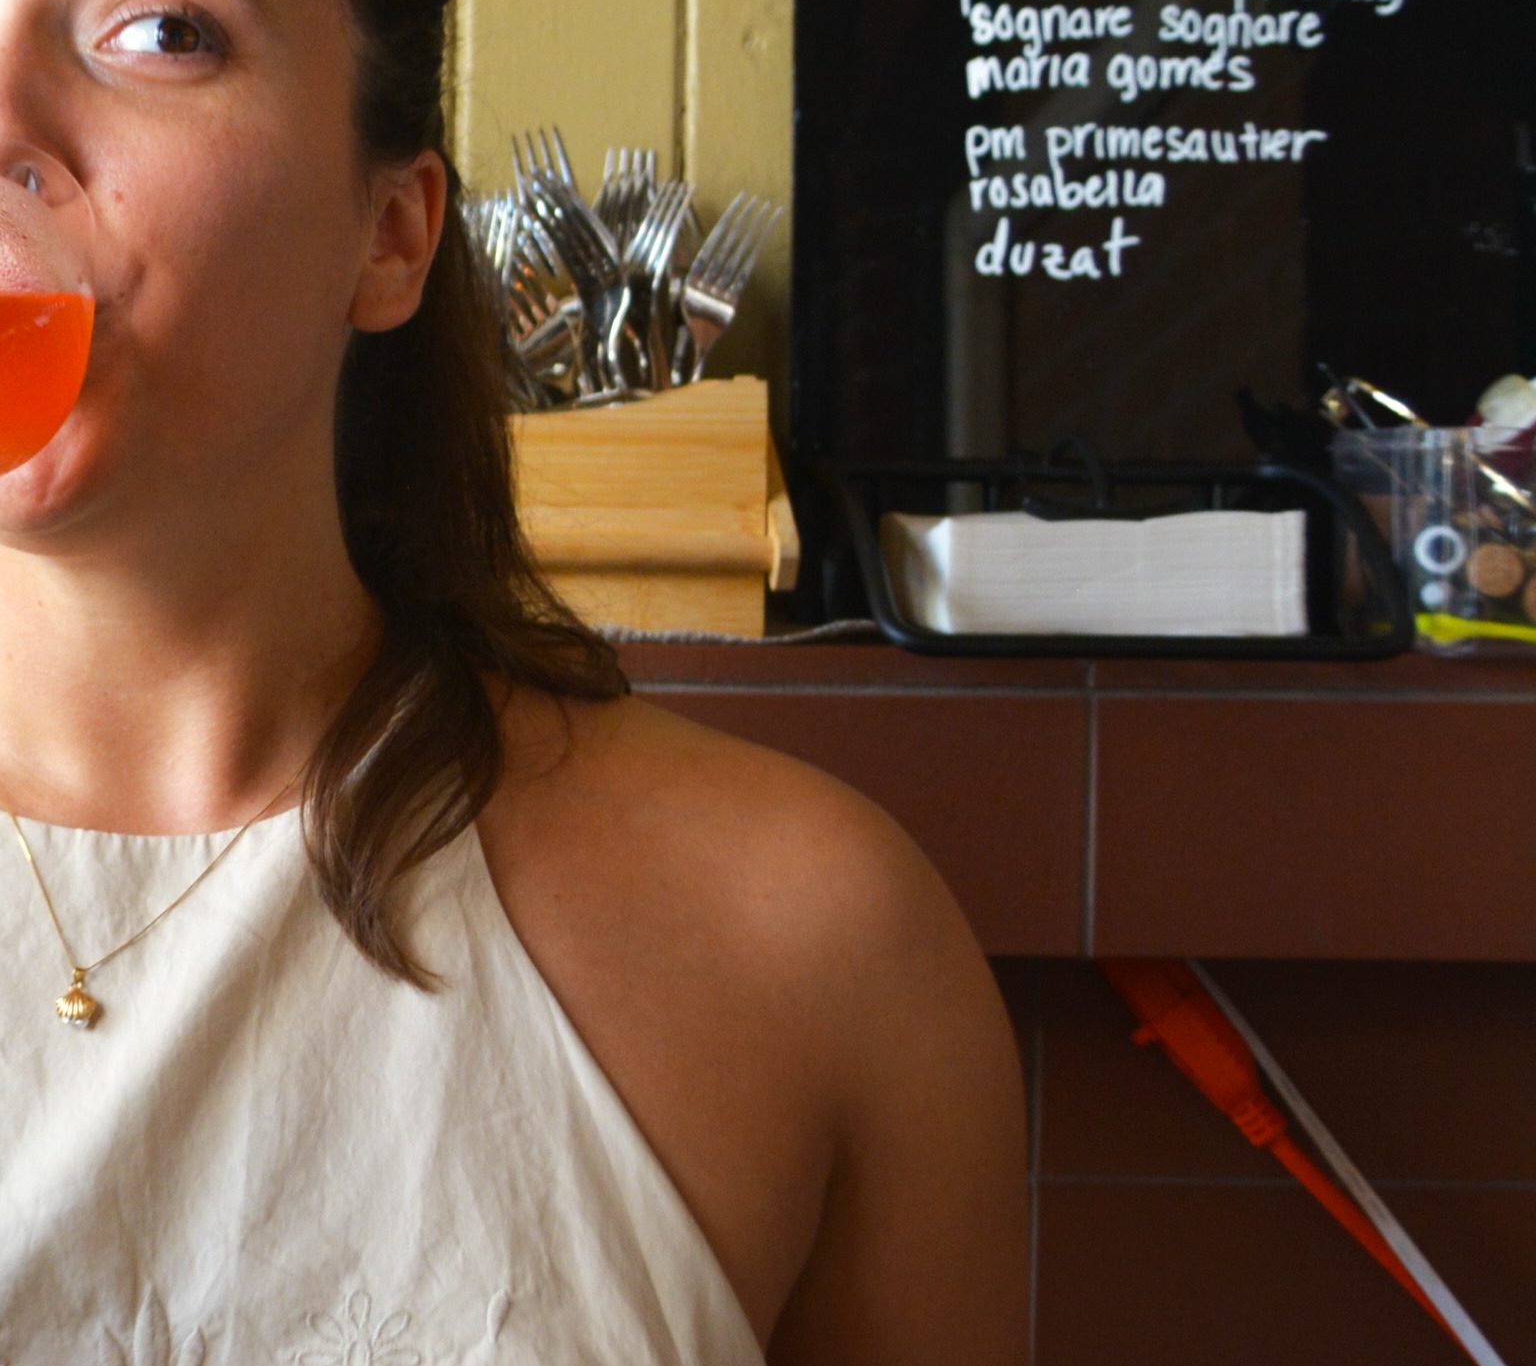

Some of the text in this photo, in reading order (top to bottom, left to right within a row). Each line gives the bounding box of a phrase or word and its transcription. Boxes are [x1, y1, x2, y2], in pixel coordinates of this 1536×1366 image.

[969, 2, 1324, 59] sognare sognare
[965, 51, 1090, 99] maria
[965, 122, 1327, 177] pm primesautier
[968, 168, 1166, 211] rosabella
[975, 216, 1140, 280] duzat
